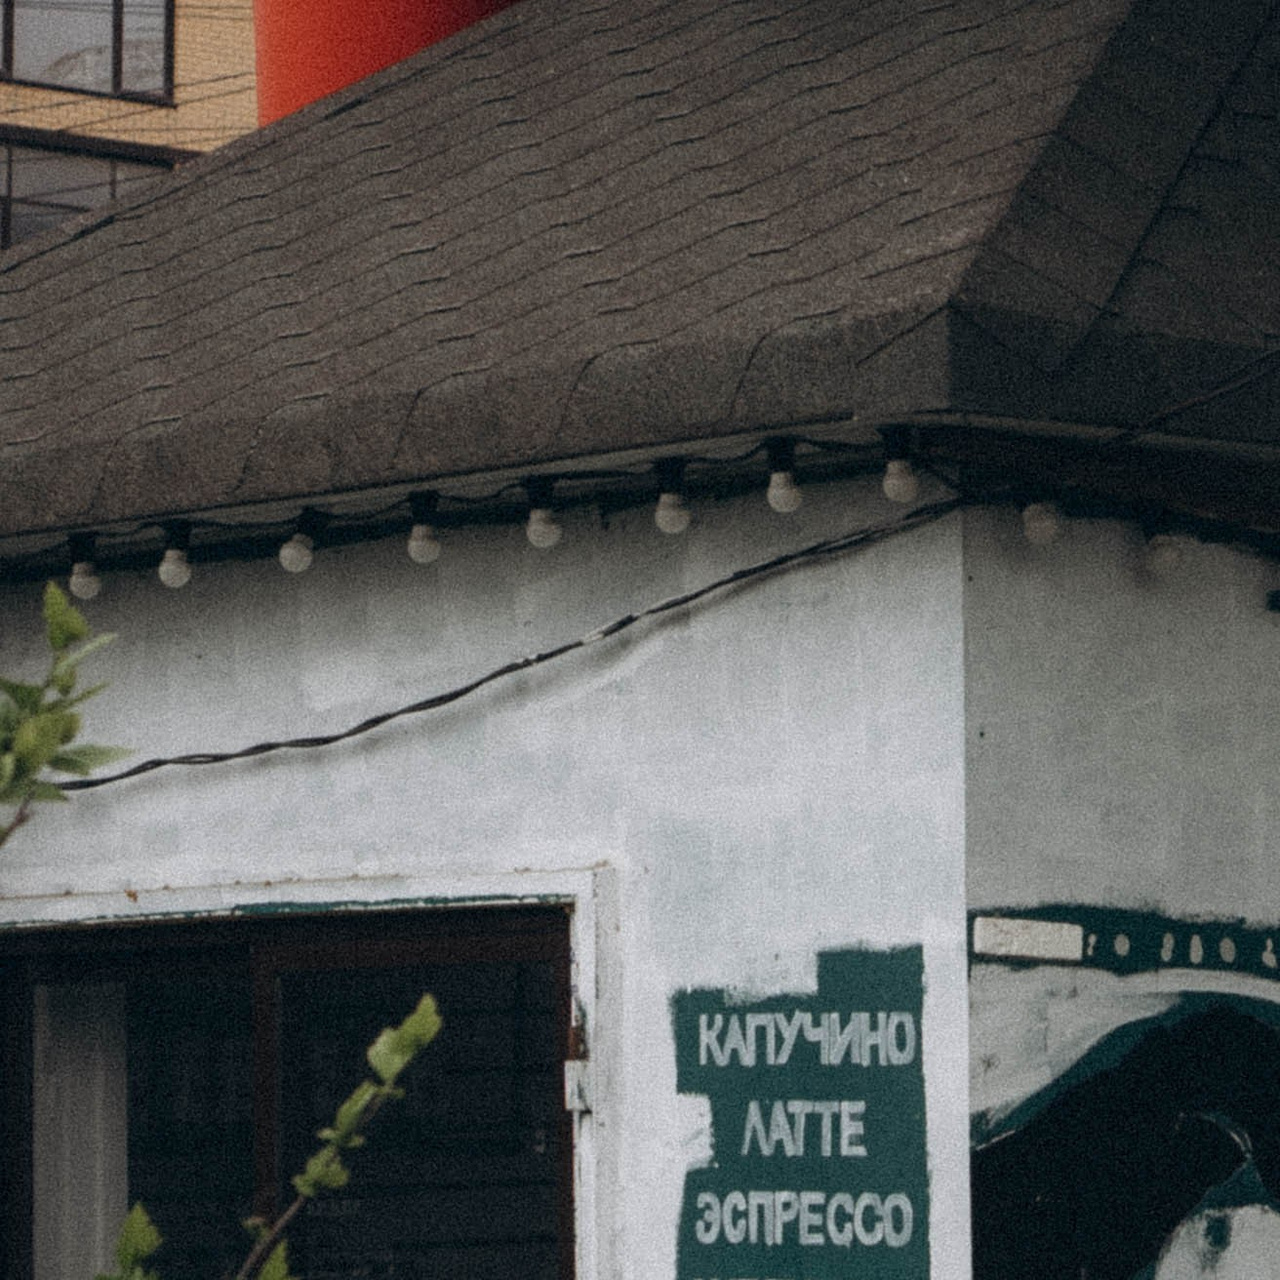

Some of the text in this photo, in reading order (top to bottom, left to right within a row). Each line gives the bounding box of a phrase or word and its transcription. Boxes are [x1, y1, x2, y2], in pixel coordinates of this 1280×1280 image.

[699, 1010, 915, 1067] КАПУЧИНО
[741, 1100, 868, 1157] ЛАТТЕ
[695, 1190, 914, 1247] ЭСПРЕССО
